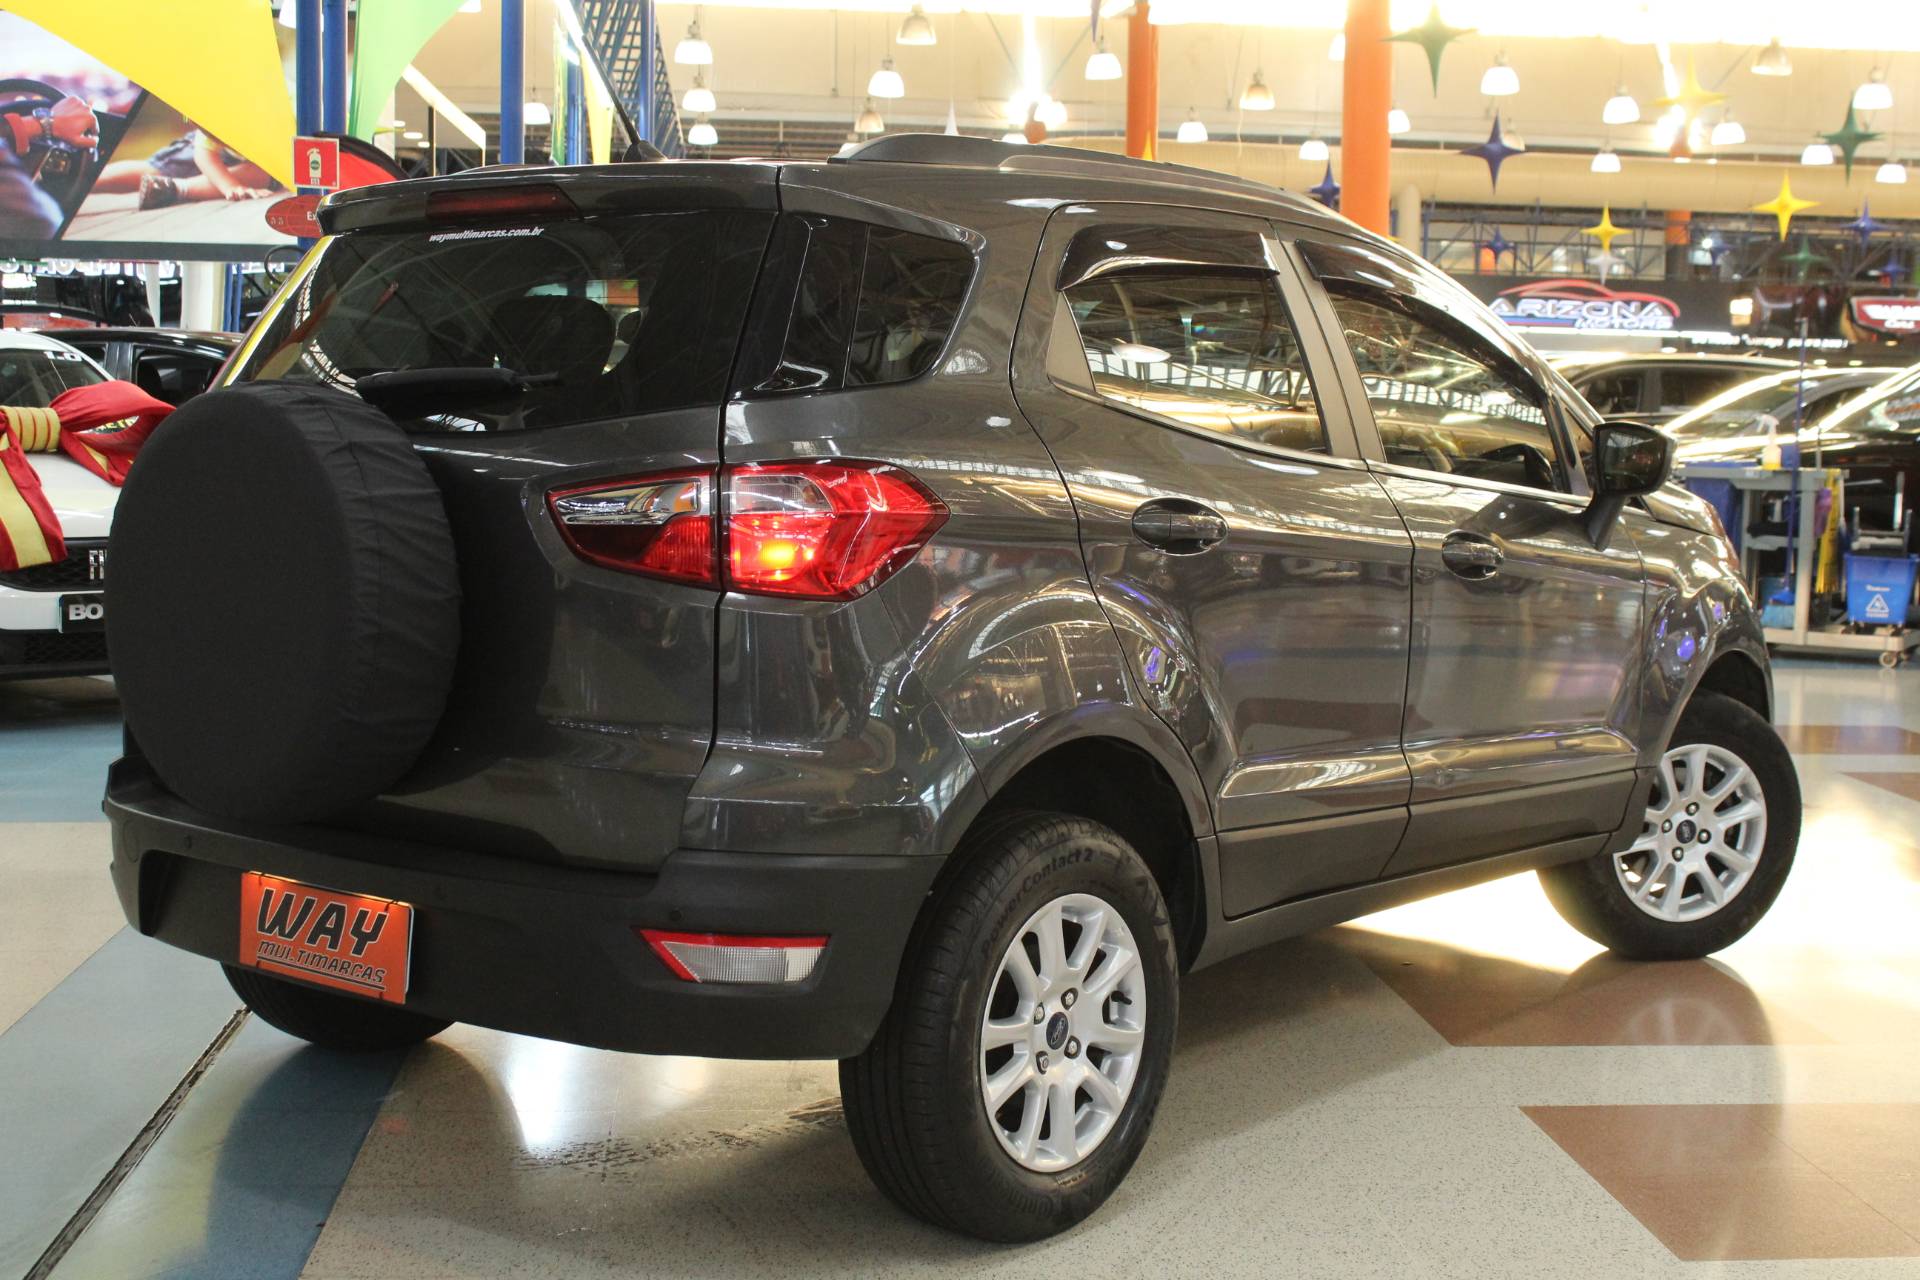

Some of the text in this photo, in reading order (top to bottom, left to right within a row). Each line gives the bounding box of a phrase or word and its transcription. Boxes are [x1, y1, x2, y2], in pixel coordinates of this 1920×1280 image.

[429, 226, 545, 243] waymultimarcas.com.br
[1488, 297, 1671, 318] ARIZONA
[1574, 316, 1674, 330] MOTORS
[88, 549, 107, 580] FI
[256, 886, 390, 958] WAY
[257, 940, 387, 984] MULTIMARCAS
